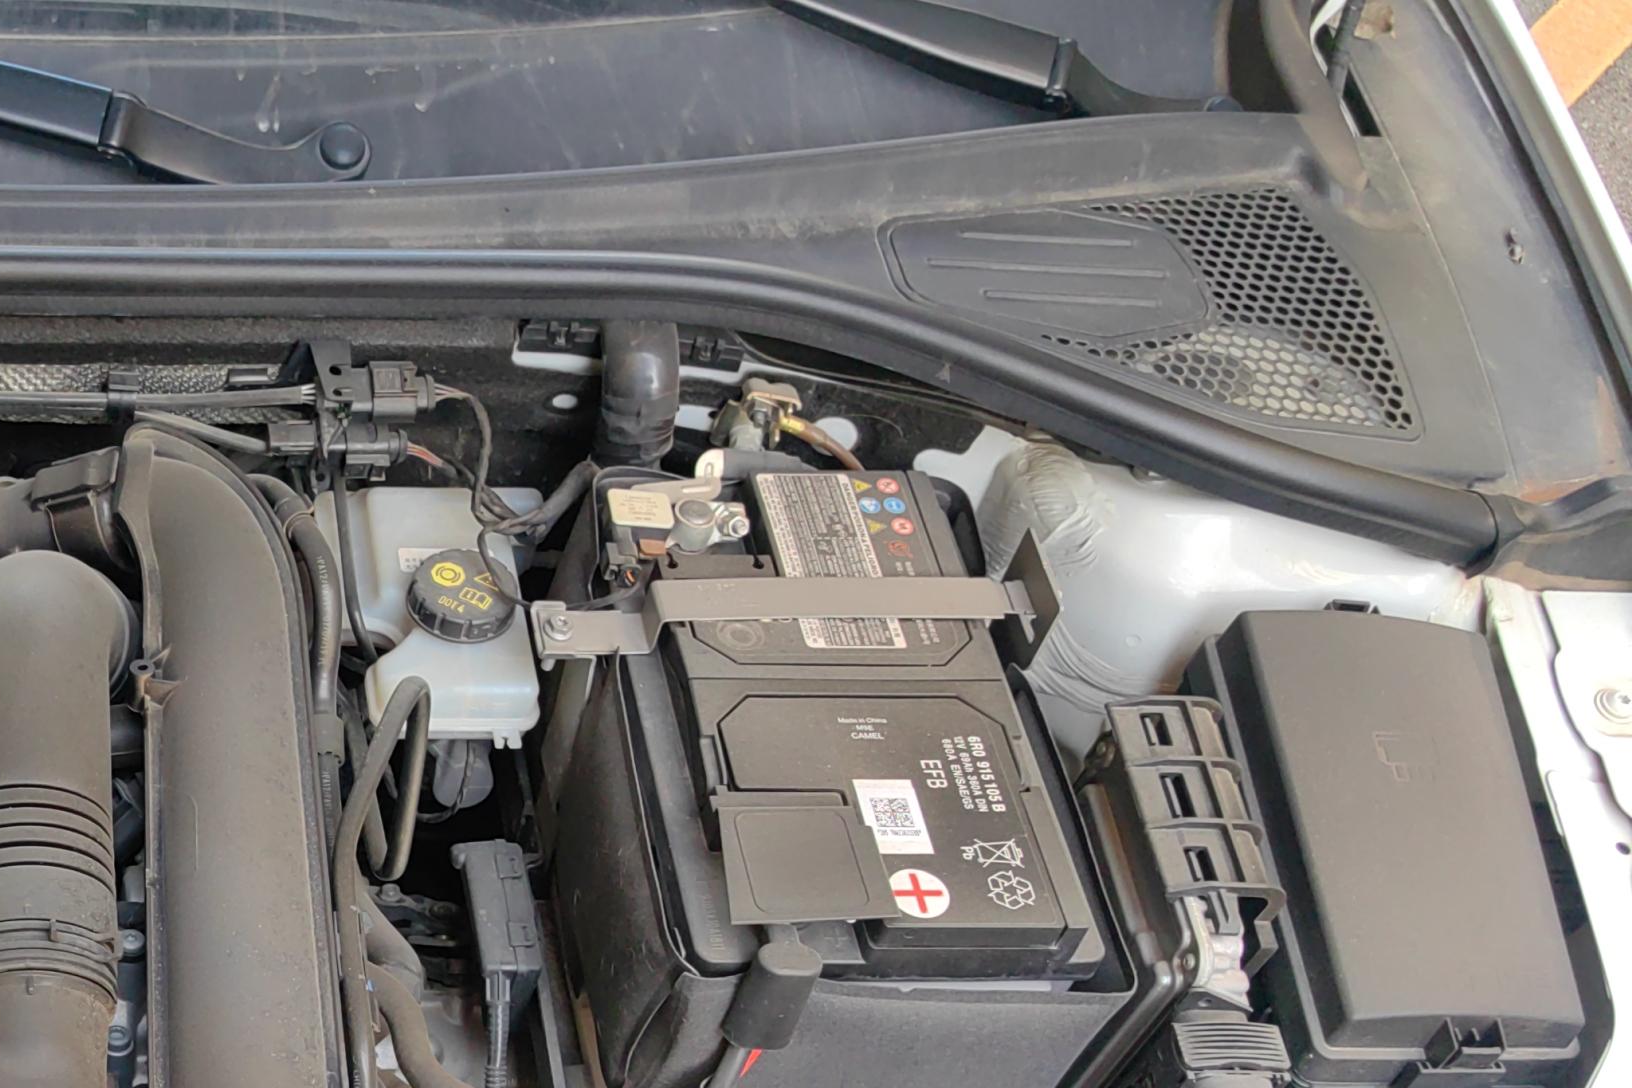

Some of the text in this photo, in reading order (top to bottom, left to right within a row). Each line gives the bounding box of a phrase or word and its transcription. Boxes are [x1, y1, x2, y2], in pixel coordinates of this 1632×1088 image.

[842, 482, 858, 511] DANGER
[851, 511, 868, 539] POISON
[863, 545, 879, 576] PELIGRO
[438, 595, 459, 609] DOT
[851, 732, 885, 740] CAMEL
[920, 759, 948, 790] EFB
[950, 762, 974, 810] EN/SAE/GS
[953, 736, 966, 751] 12V
[975, 798, 990, 812] DIN
[968, 736, 1007, 812] 6R0 915 105 B
[960, 846, 974, 861] Pb
